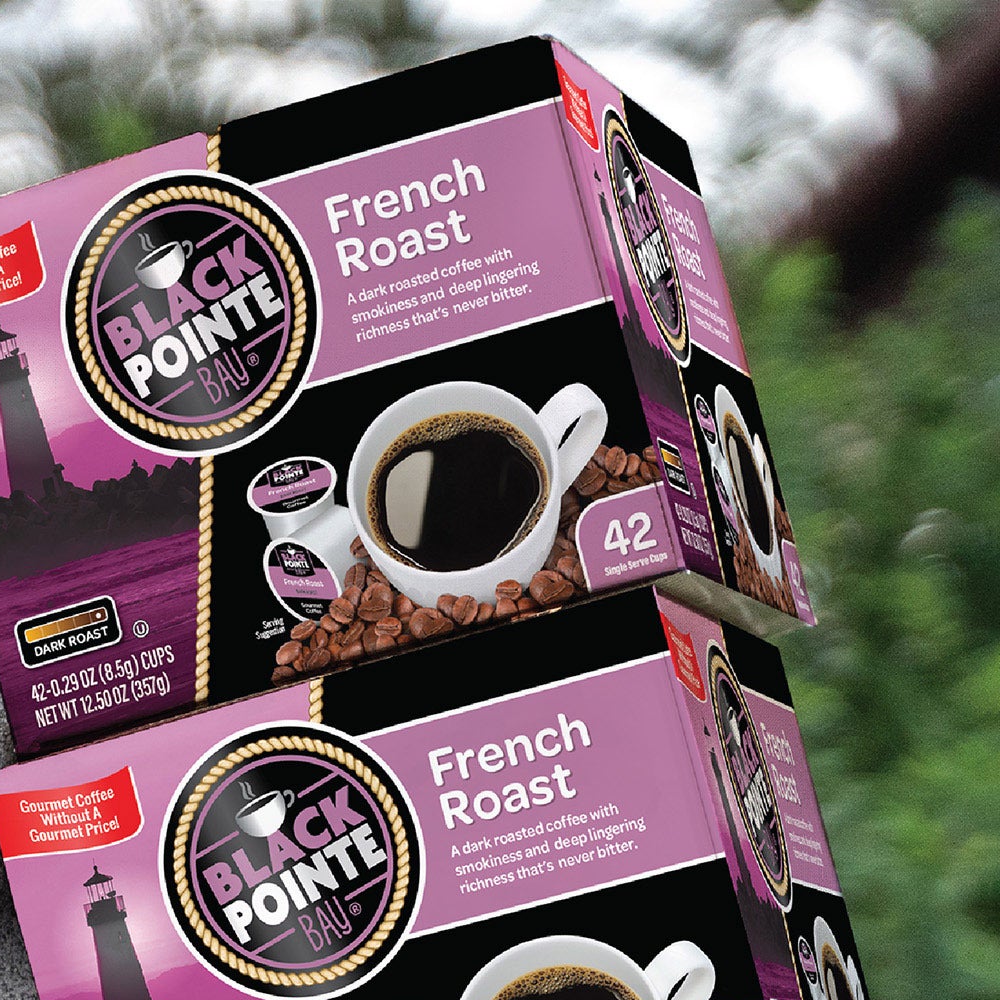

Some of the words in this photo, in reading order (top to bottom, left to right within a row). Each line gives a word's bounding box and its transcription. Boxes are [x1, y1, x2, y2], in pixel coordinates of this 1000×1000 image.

[324, 158, 486, 234] French
[335, 210, 472, 277] Roast
[104, 234, 264, 360] BLACK
[347, 292, 357, 305] A
[358, 282, 388, 304] dark
[390, 267, 439, 292] roasted
[441, 257, 482, 278] coffee
[483, 247, 513, 268] with
[351, 294, 418, 324] smokiness
[420, 285, 445, 304] and
[449, 277, 482, 298] deep
[483, 260, 541, 285] lingering
[123, 272, 285, 399] POINTE
[356, 316, 410, 342] richness
[412, 306, 449, 327] that's
[453, 295, 489, 315] never
[491, 283, 532, 304] bitter.
[603, 511, 657, 556] 42
[604, 558, 627, 577] Single
[628, 556, 650, 571] Serve
[650, 551, 668, 566] Cups
[34, 637, 67, 657] DARK
[68, 625, 109, 648] ROAST
[31, 673, 79, 702] 42-0.29
[80, 667, 98, 688] OZ
[99, 654, 139, 685] (8.5g)
[141, 645, 175, 670] CUPS
[35, 704, 58, 728] NET
[58, 699, 79, 721] WT
[80, 689, 112, 715] 12.50
[112, 684, 130, 704] OZ
[131, 672, 171, 702] (357g)
[428, 713, 592, 787] French
[20, 796, 74, 813] Gourmet
[75, 788, 115, 807] Coffee
[40, 808, 91, 826] Without
[93, 806, 102, 820] A
[439, 764, 577, 831] Roast
[29, 825, 84, 842] Gourmet
[85, 815, 120, 837] Price!
[203, 785, 367, 904] BLACK
[451, 845, 461, 858] A
[462, 836, 492, 855] dark
[494, 821, 544, 846] roasted
[546, 813, 588, 833] coffee
[589, 802, 620, 821] with
[455, 848, 523, 877] smokiness
[524, 840, 550, 858] and
[554, 831, 588, 850] deep
[589, 816, 647, 842] lingering
[222, 823, 388, 945] POINTE
[459, 868, 515, 894] richness
[516, 859, 554, 879] that's
[558, 849, 595, 869] never
[597, 838, 638, 858] bitter.
